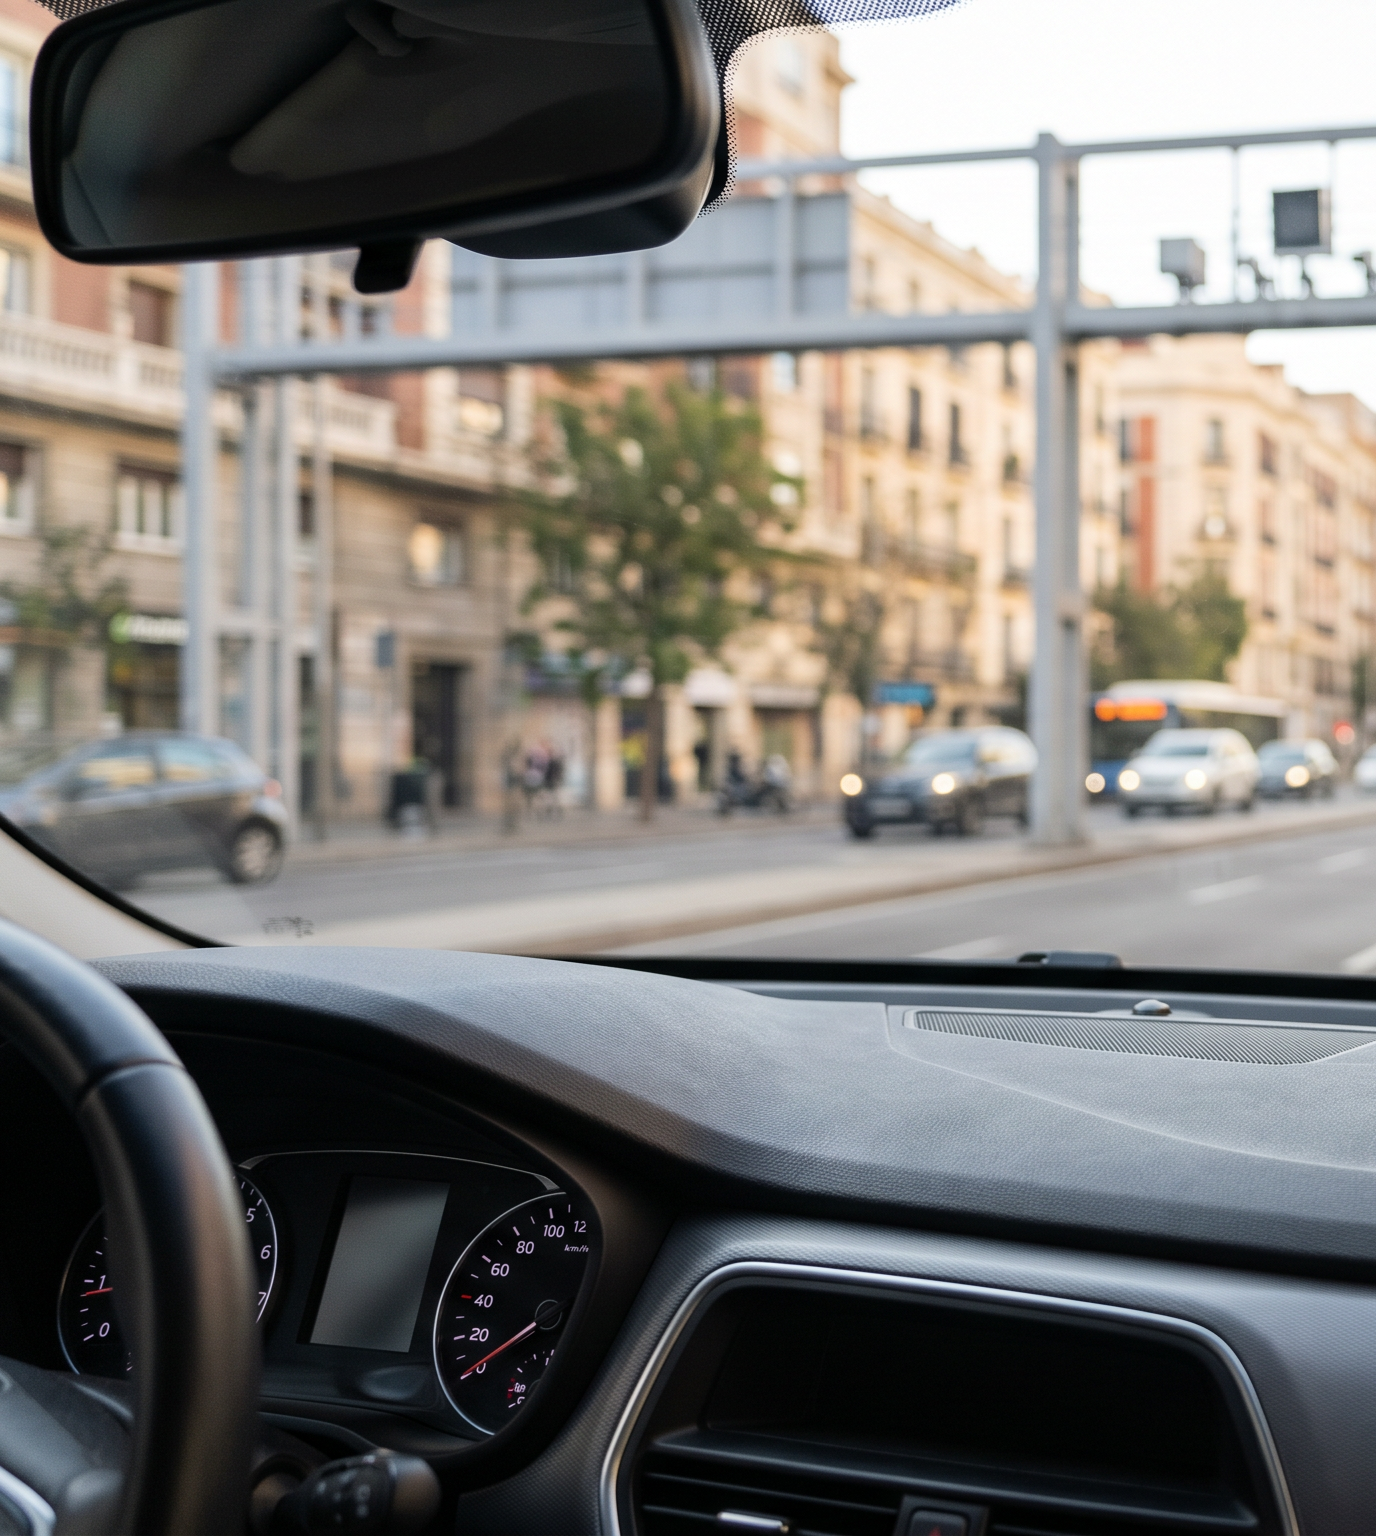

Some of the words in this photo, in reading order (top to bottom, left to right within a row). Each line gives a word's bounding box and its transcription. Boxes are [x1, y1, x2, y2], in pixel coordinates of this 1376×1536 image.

[246, 1208, 256, 1222] 5
[544, 1225, 564, 1237] 100
[261, 1245, 271, 1259] 6
[516, 1241, 534, 1254] 80
[564, 1244, 589, 1252] km/h
[490, 1263, 509, 1277] 60
[99, 1275, 106, 1290] 1
[258, 1292, 267, 1306] 7
[474, 1295, 493, 1308] 40
[99, 1322, 110, 1337] 0
[470, 1328, 489, 1342] 20
